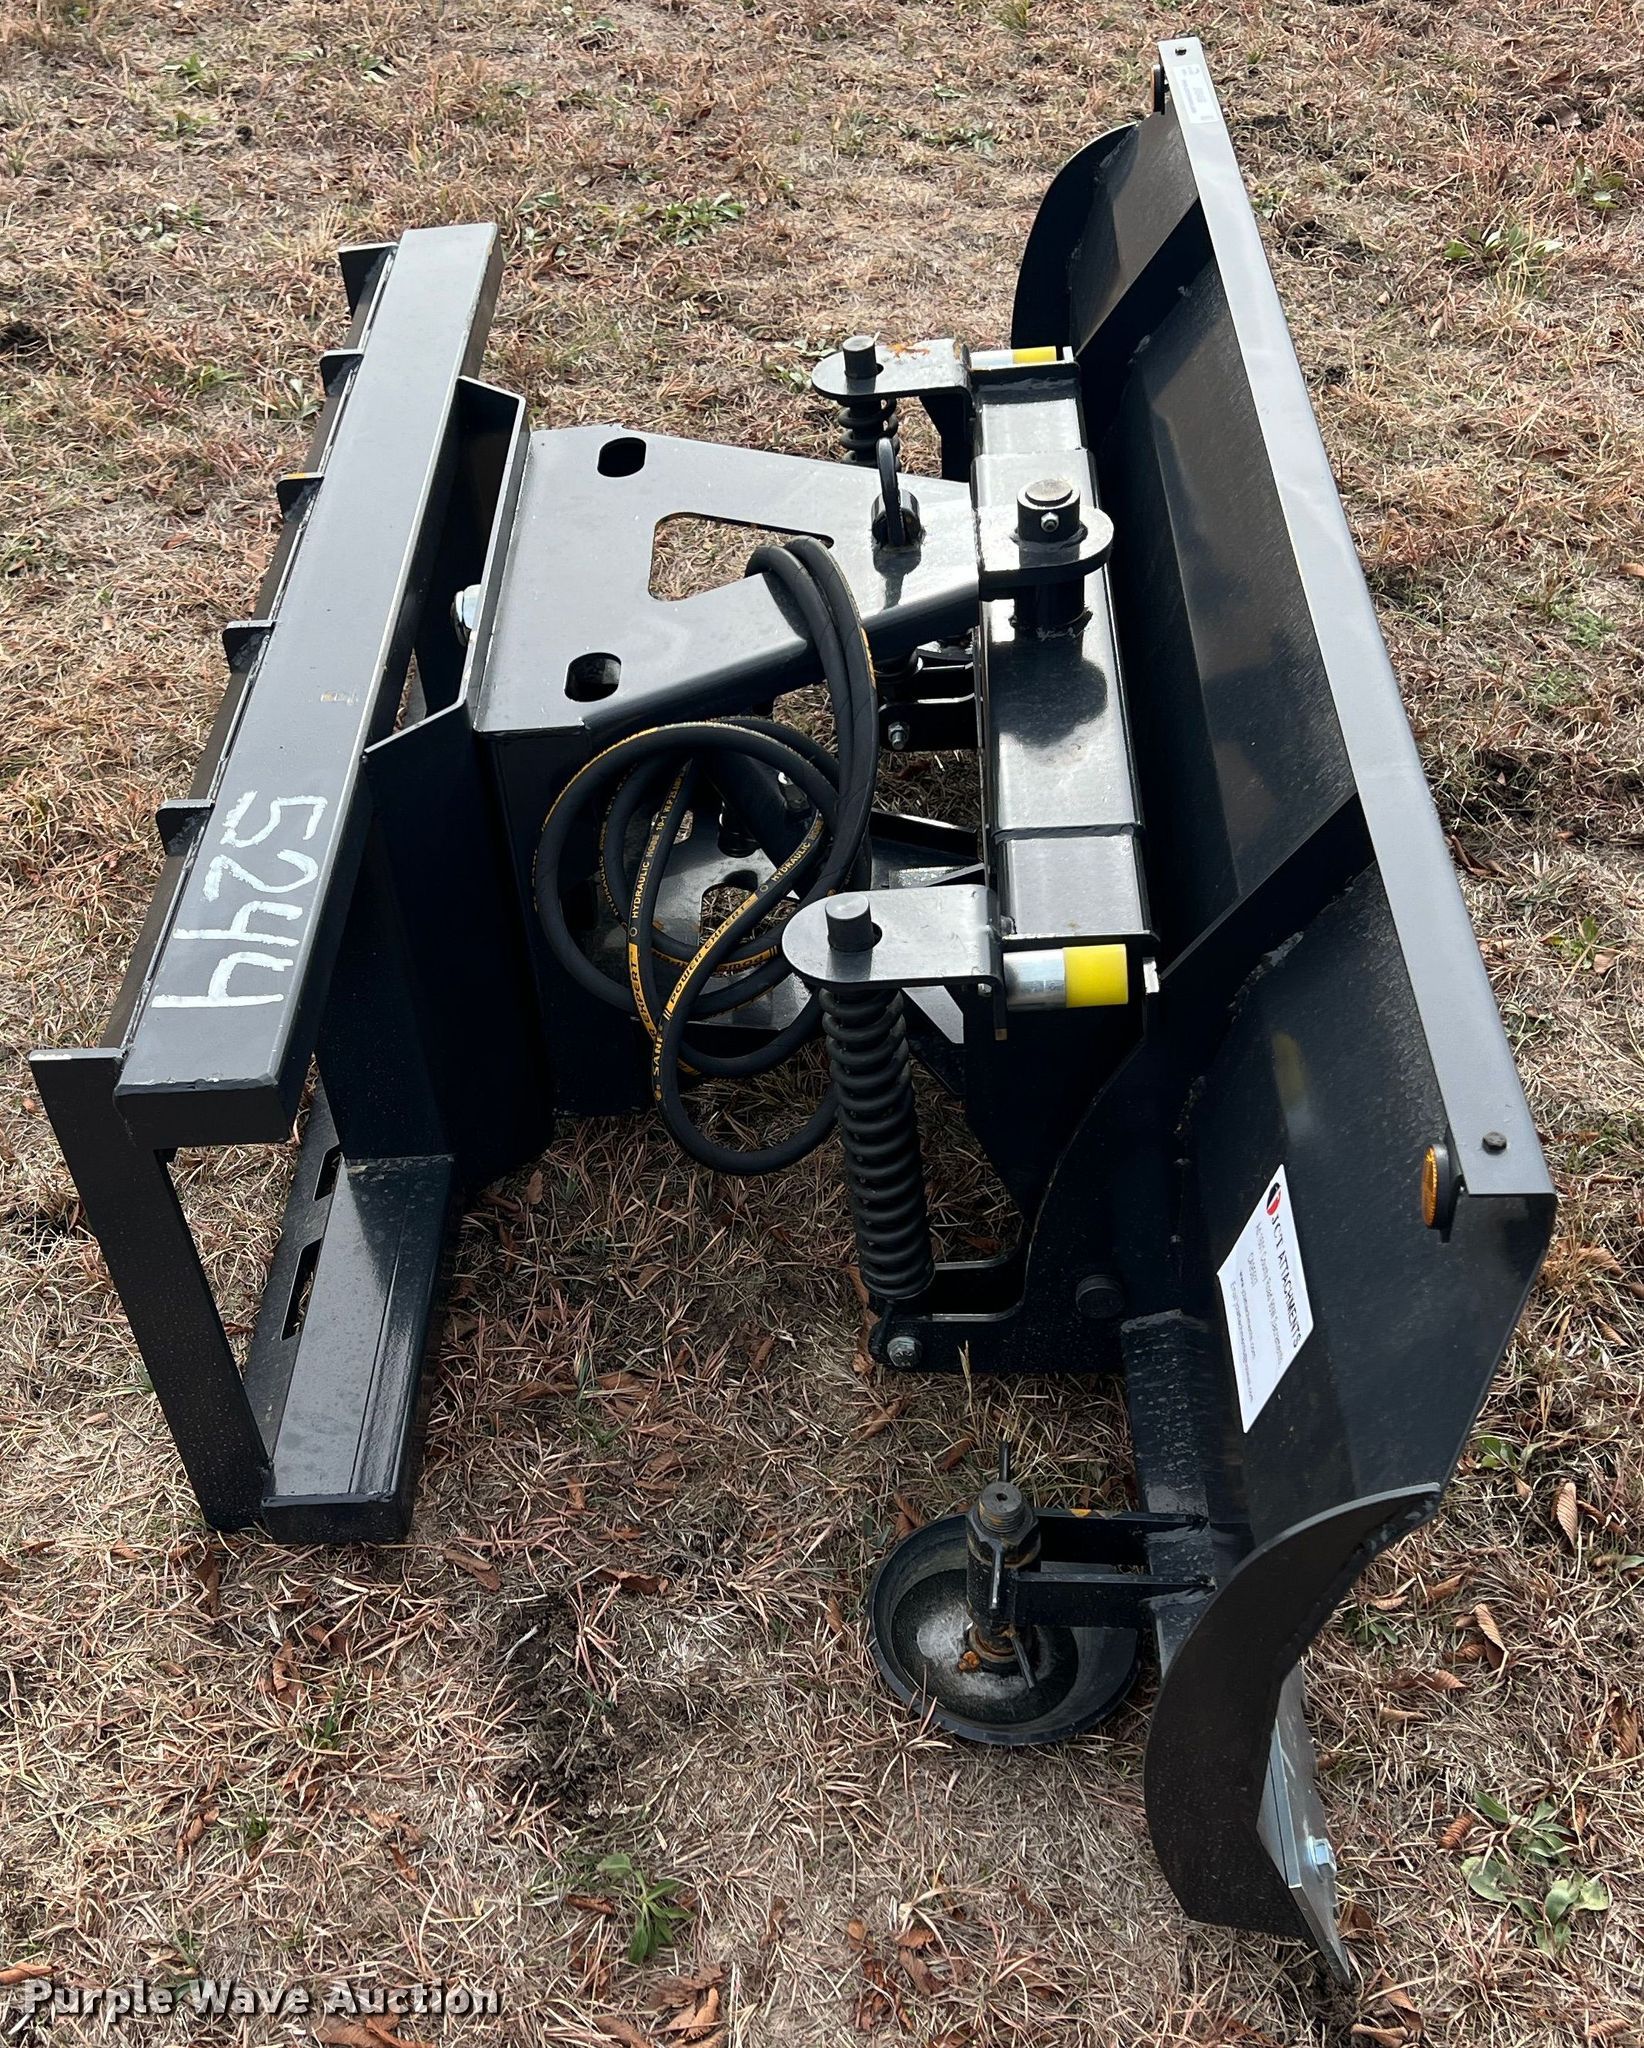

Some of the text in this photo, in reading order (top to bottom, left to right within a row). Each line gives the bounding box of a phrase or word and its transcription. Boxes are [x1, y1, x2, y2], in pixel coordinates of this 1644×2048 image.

[151, 790, 329, 1009] 5244
[631, 861, 650, 919] HYDRAULIC
[770, 841, 812, 883] HYDRAULIC
[631, 961, 652, 1024] EXPERT
[668, 951, 704, 1004] POWER
[704, 903, 748, 951] EXPERT
[1271, 1213, 1302, 1349] JCT ATTACHMENTS
